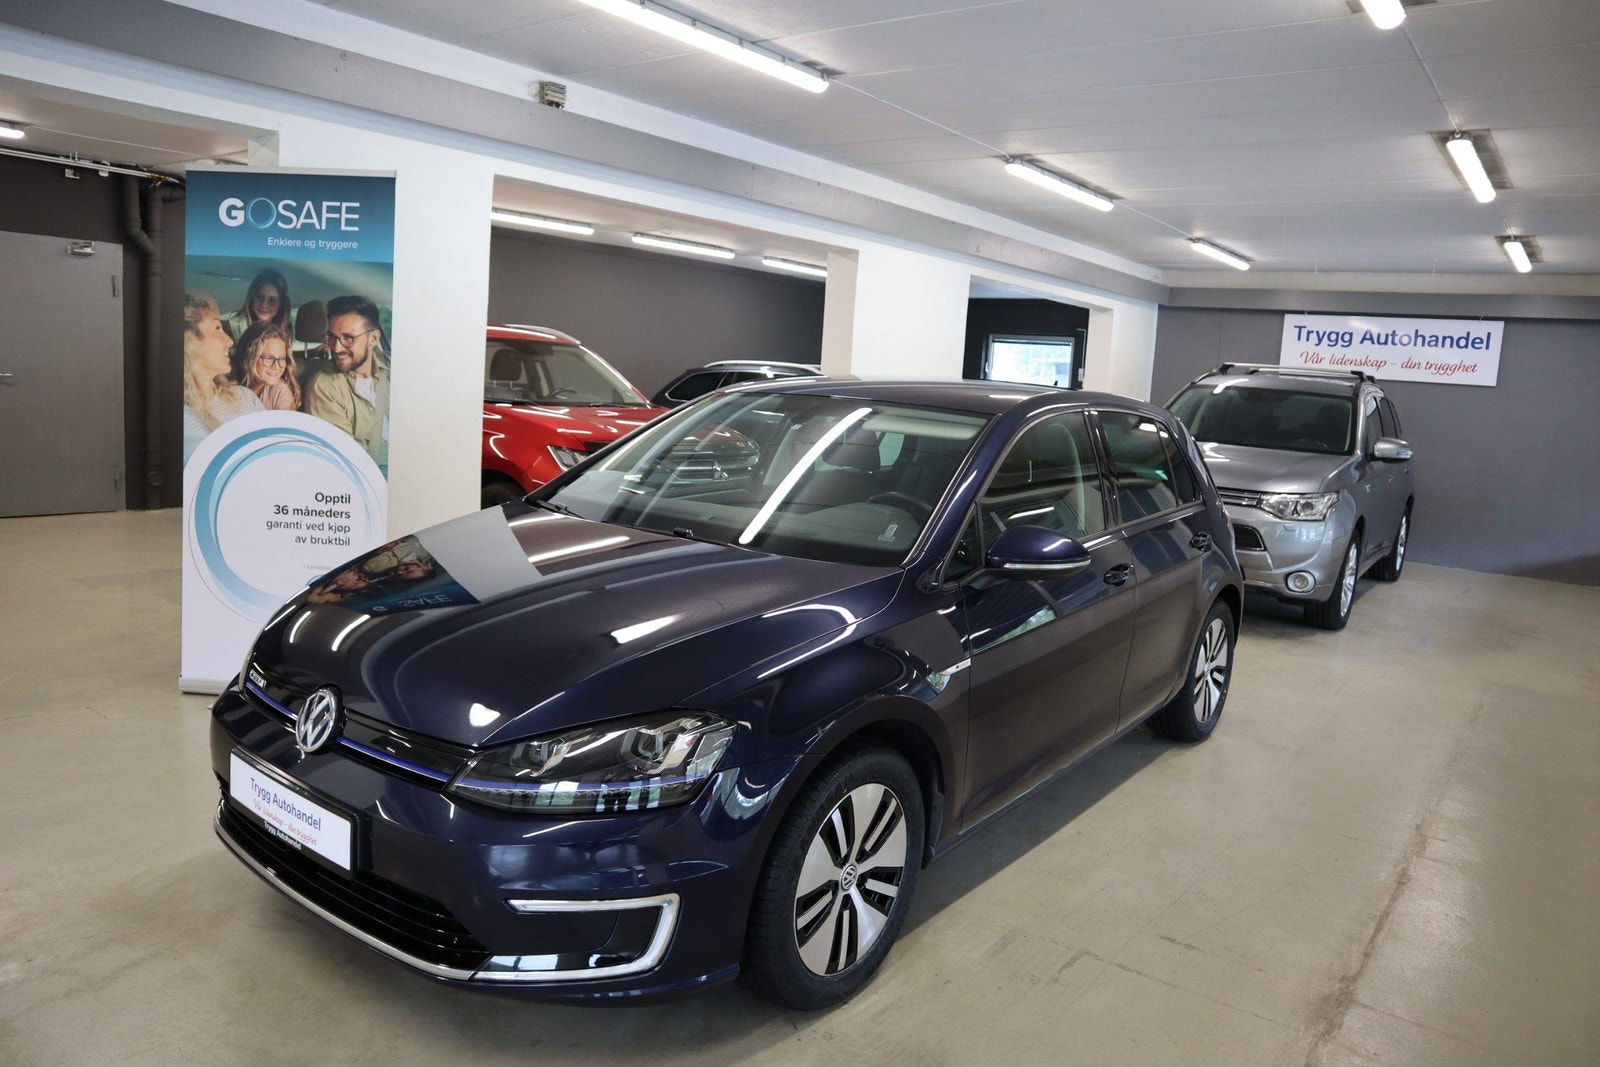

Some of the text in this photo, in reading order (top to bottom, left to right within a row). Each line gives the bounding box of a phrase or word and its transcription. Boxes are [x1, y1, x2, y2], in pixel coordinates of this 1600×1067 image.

[218, 197, 360, 231] GOSAFE
[267, 237, 358, 250] Enklere og tryggere
[1293, 325, 1491, 350] Trygg Autohandel
[1299, 350, 1326, 365] Vår
[1328, 352, 1387, 371] lidenskap
[1401, 357, 1422, 370] din
[1424, 359, 1478, 376] trygghet
[315, 492, 351, 505] Opptil
[273, 504, 351, 519] 36 måneders
[266, 520, 351, 534] garanti ved kjøp
[295, 535, 350, 546] av bruktbil
[250, 777, 321, 831] Trygg Autohandel
